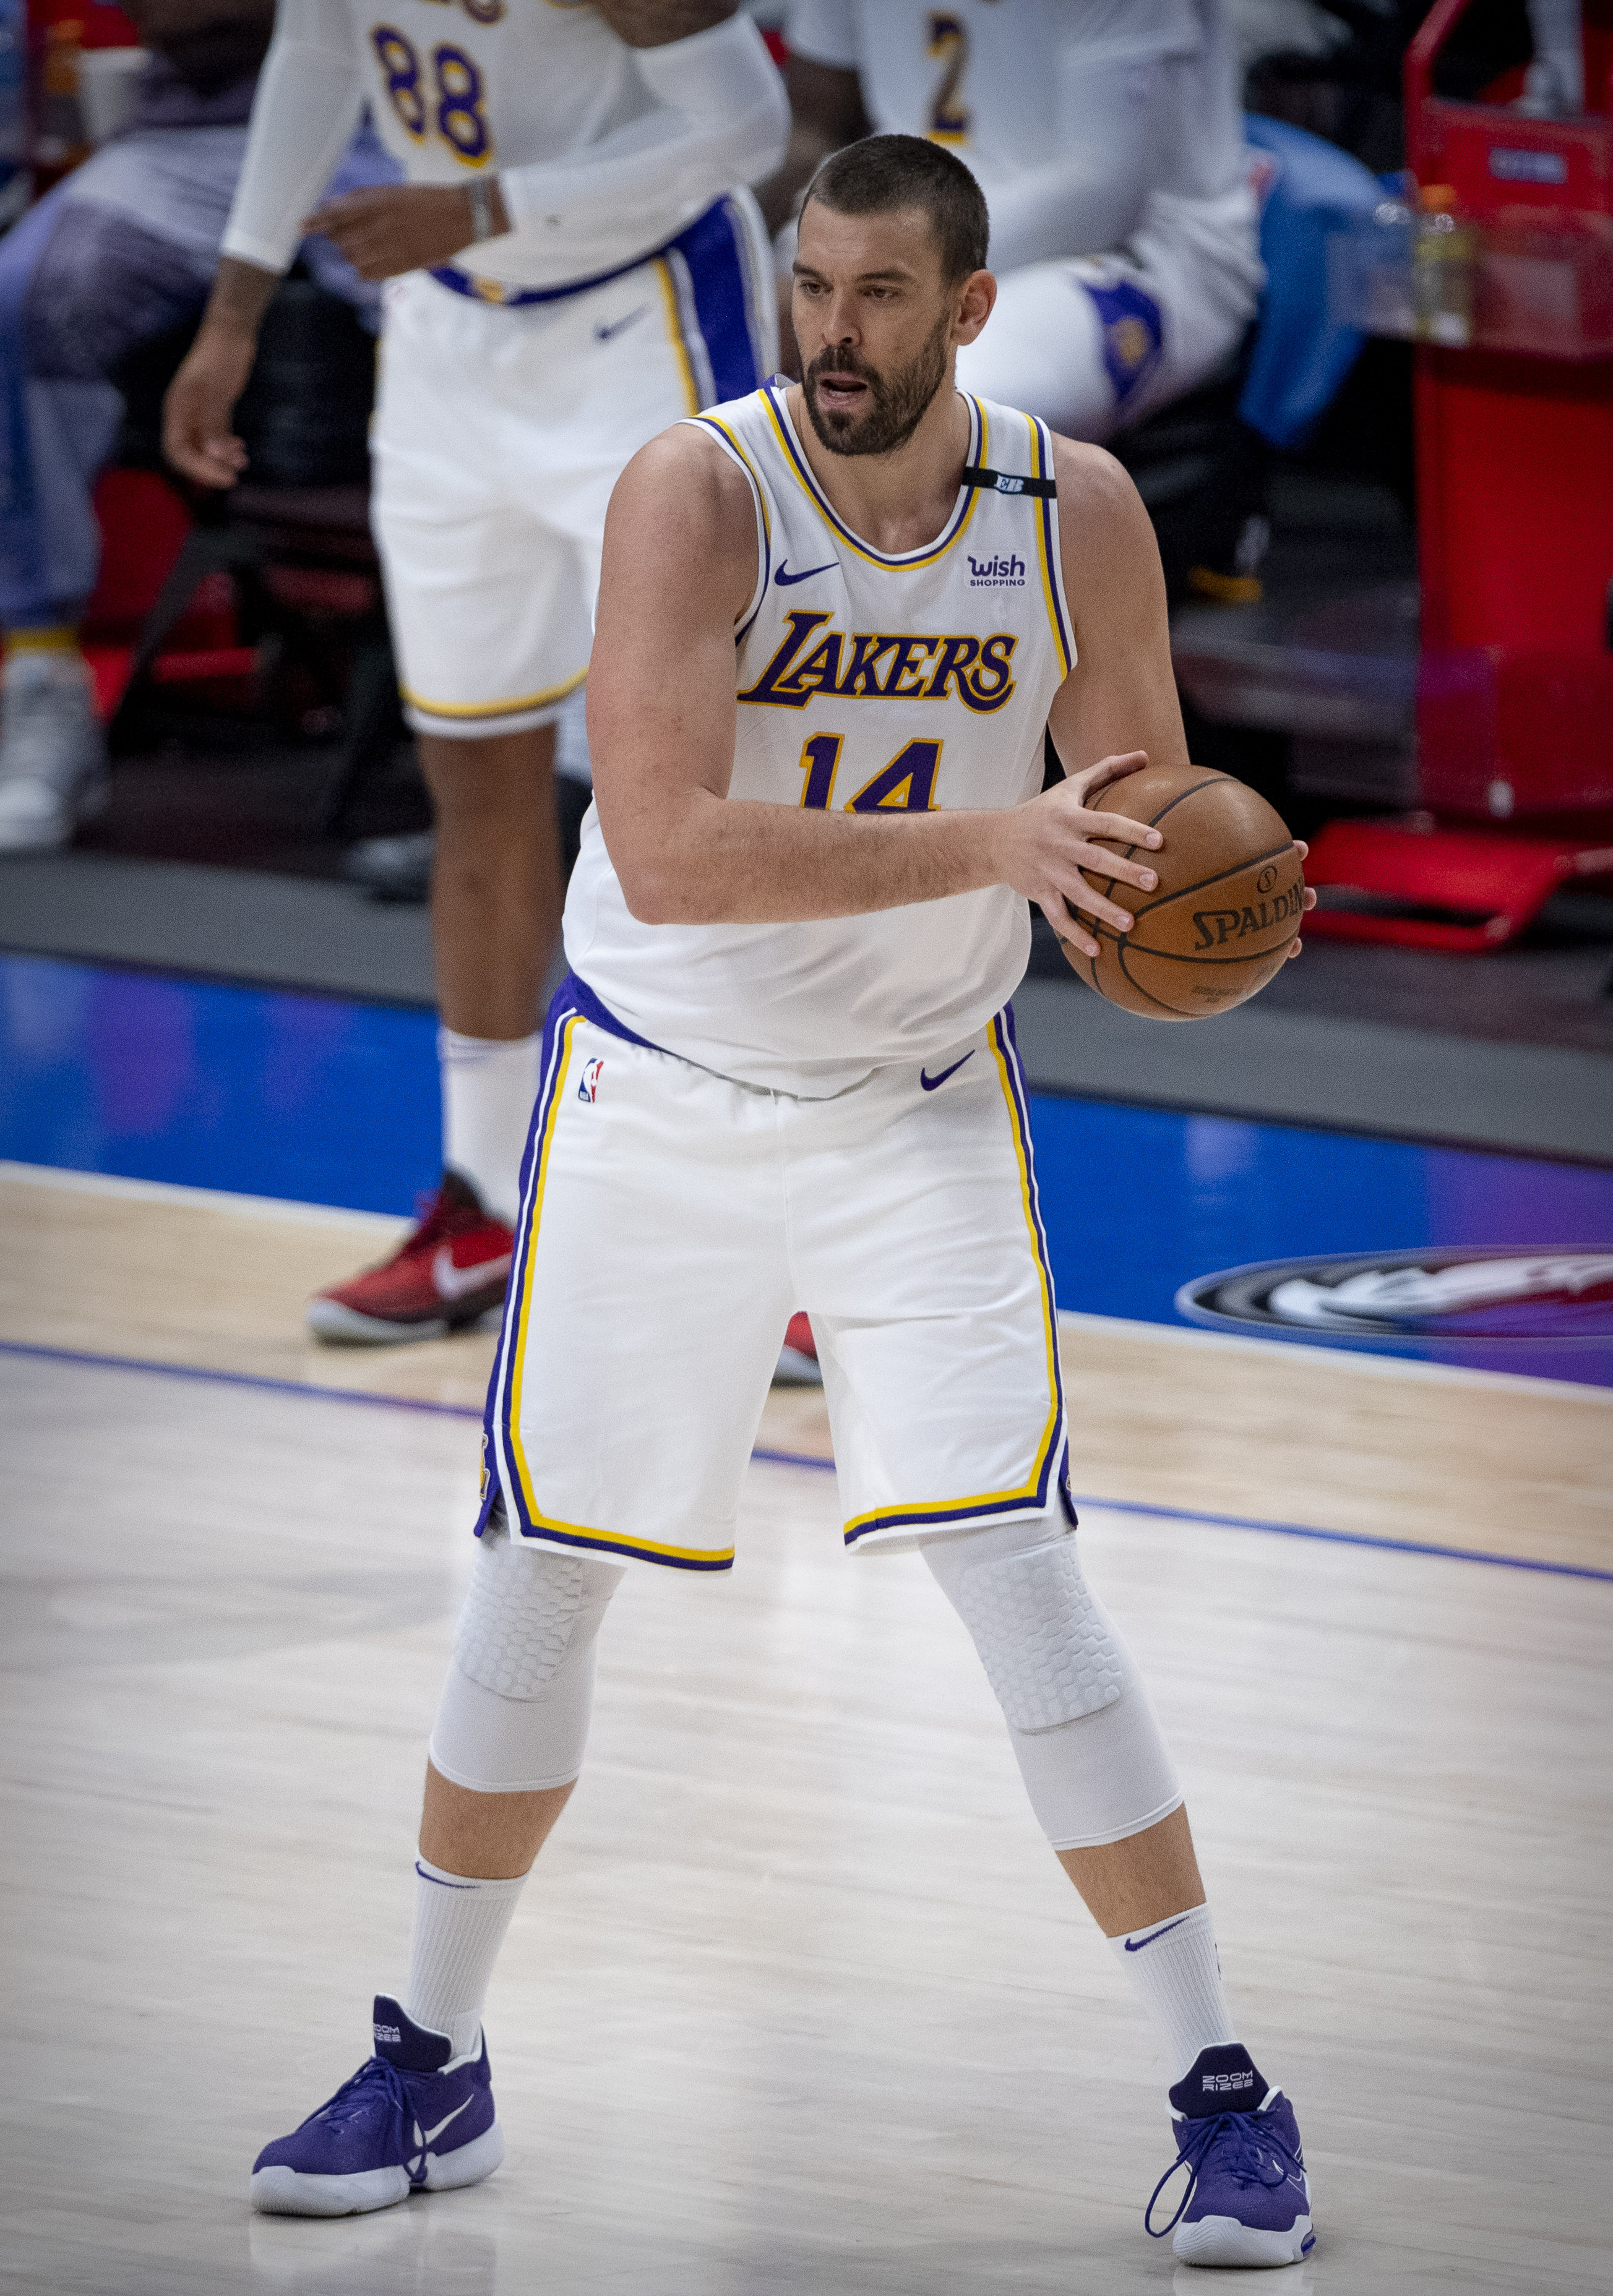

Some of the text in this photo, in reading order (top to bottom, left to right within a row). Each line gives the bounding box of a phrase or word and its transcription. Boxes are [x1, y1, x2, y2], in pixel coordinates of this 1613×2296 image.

[369, 21, 494, 169] 88
[924, 9, 971, 147] 2
[967, 554, 1025, 576] wish
[737, 609, 1019, 714] LAKERS
[799, 731, 944, 814] 14
[1202, 2070, 1253, 2083] ZOOM
